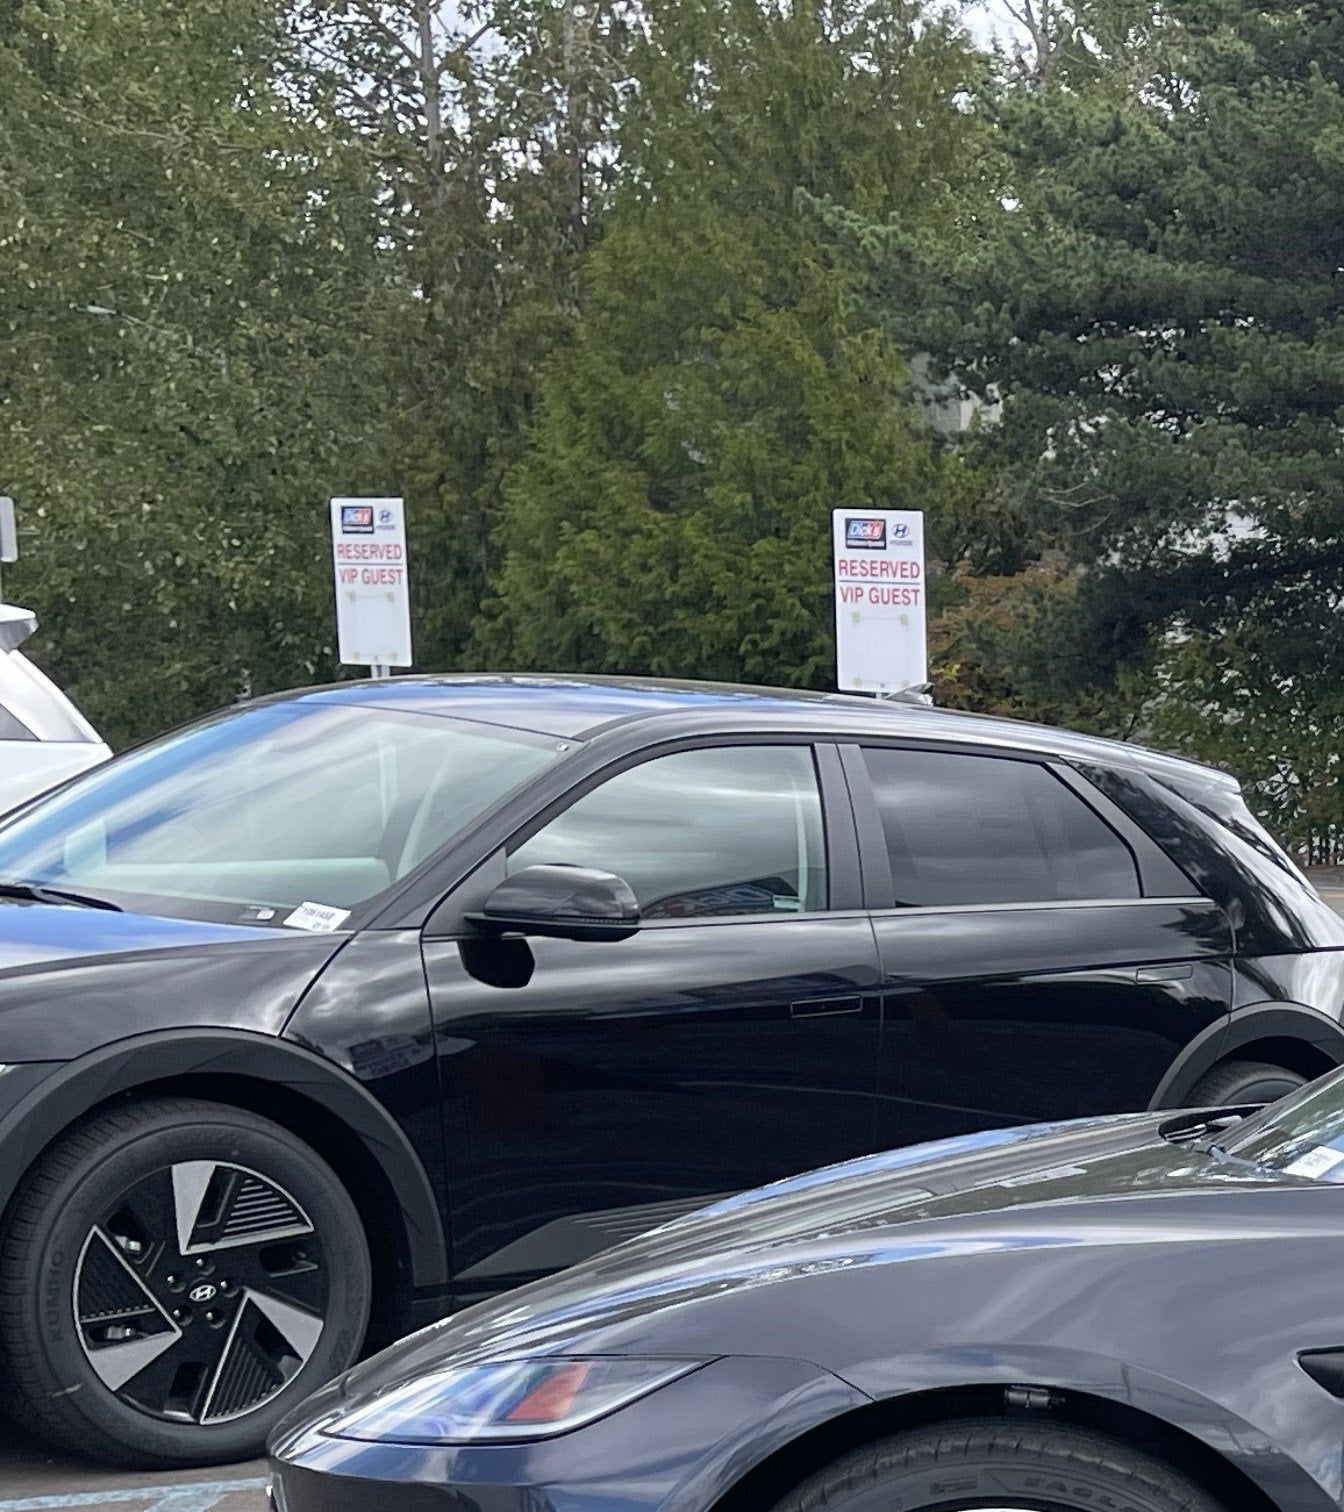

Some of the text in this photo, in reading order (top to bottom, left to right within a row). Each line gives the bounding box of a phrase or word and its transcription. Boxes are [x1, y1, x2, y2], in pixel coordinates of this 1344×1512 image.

[336, 543, 402, 561] RESERVED
[339, 568, 403, 585] VIP GUEST
[838, 559, 920, 579] RESERVED
[840, 586, 920, 606] VIP GUEST
